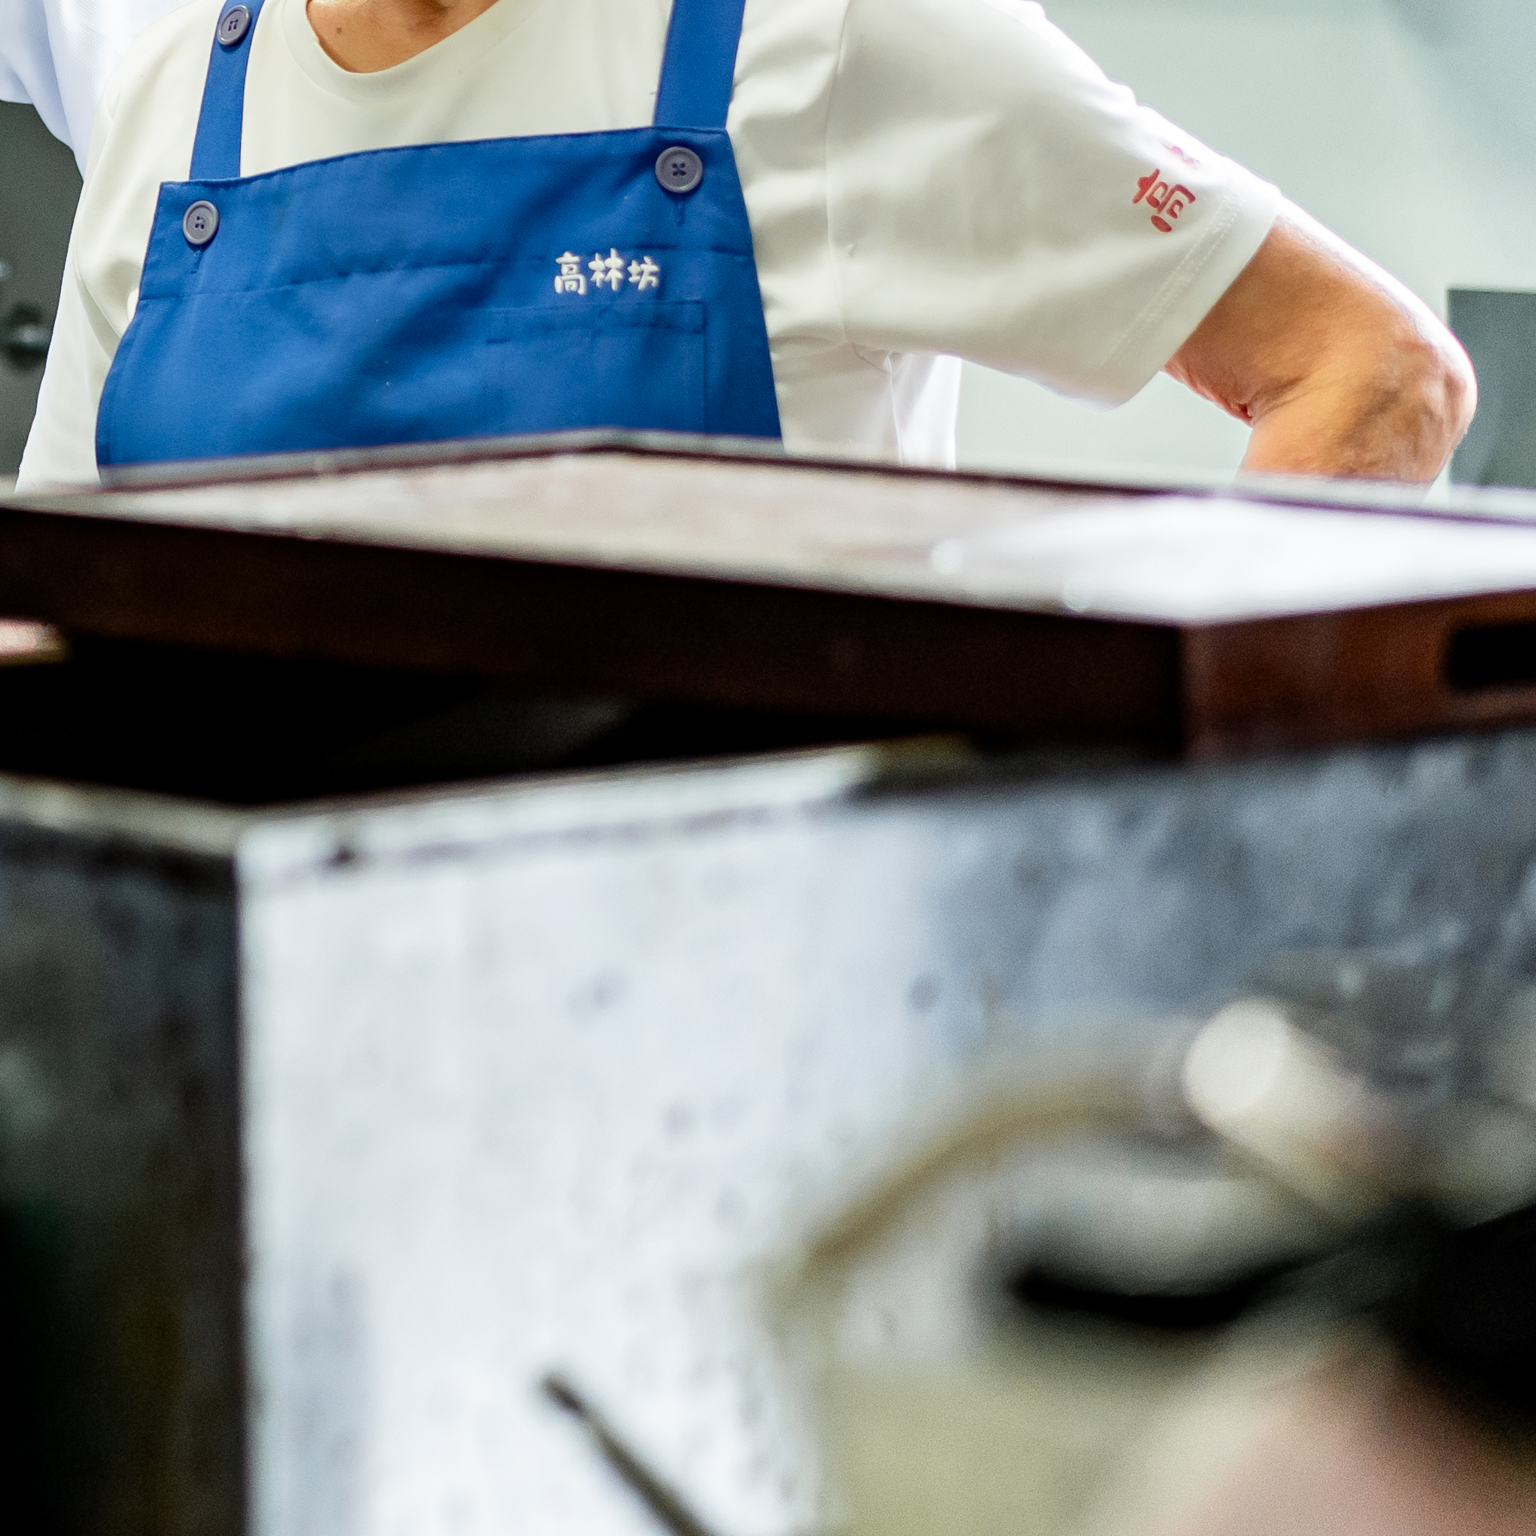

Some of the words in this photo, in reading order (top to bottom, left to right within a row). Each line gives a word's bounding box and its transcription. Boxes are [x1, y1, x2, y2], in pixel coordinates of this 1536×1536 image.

[1132, 141, 1200, 233] 高
[554, 247, 662, 296] 高林坊
